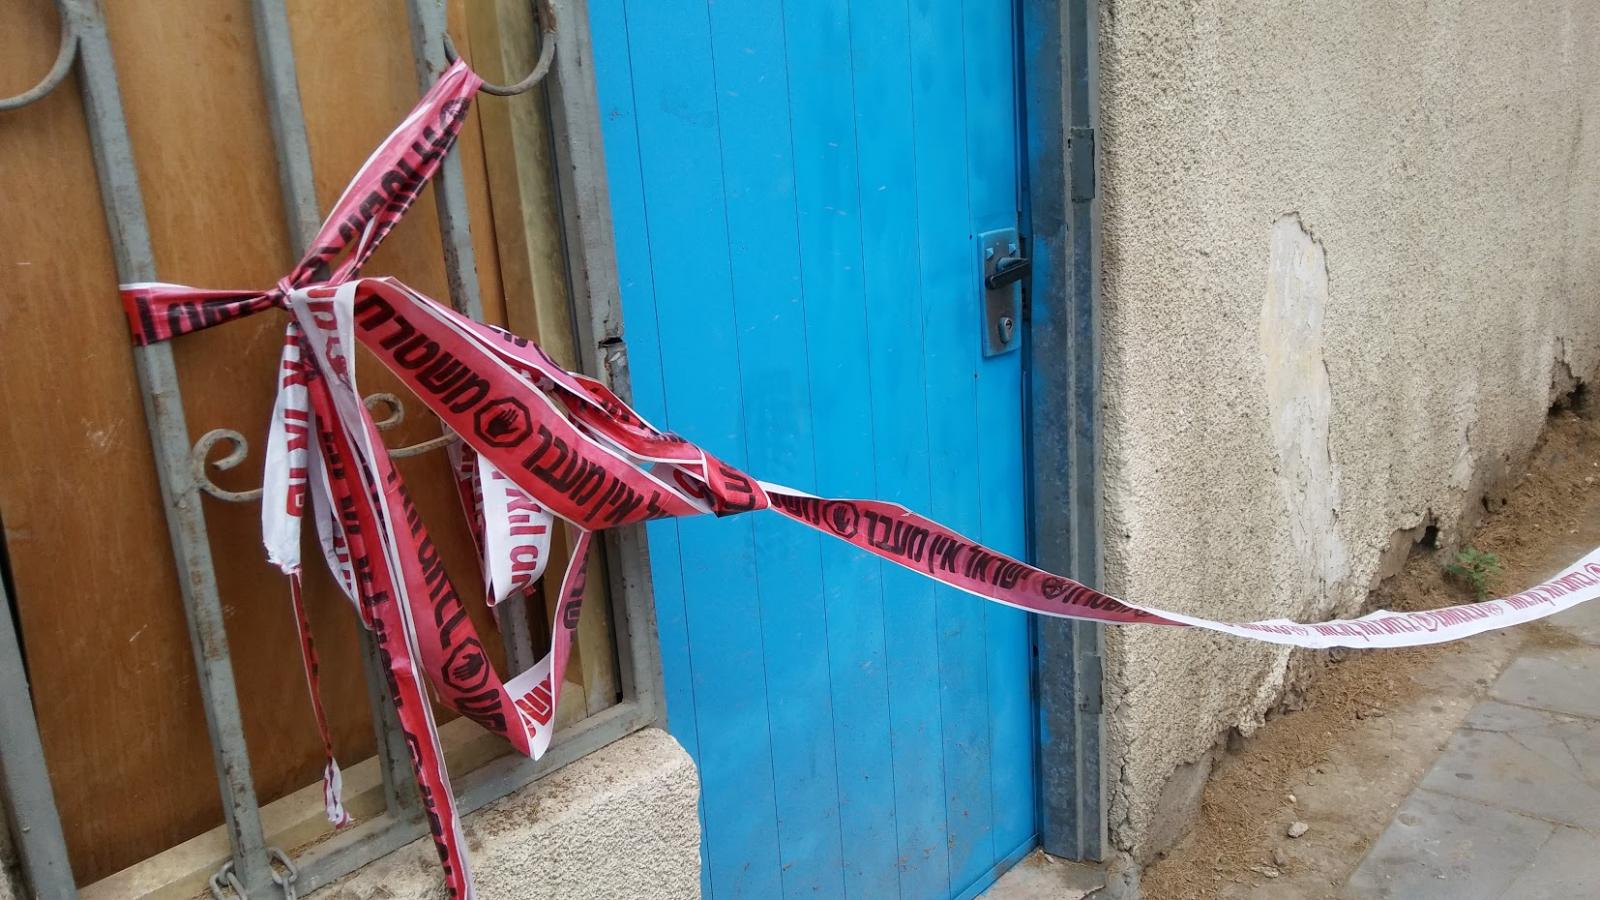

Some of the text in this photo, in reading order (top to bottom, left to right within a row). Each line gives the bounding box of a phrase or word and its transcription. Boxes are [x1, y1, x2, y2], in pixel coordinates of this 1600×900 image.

[355, 294, 490, 415] משטרת
[522, 424, 607, 504] מעבר
[586, 479, 645, 523] אין
[863, 510, 925, 563] מעבר
[928, 534, 961, 573] אין
[963, 544, 1035, 590] ישראל
